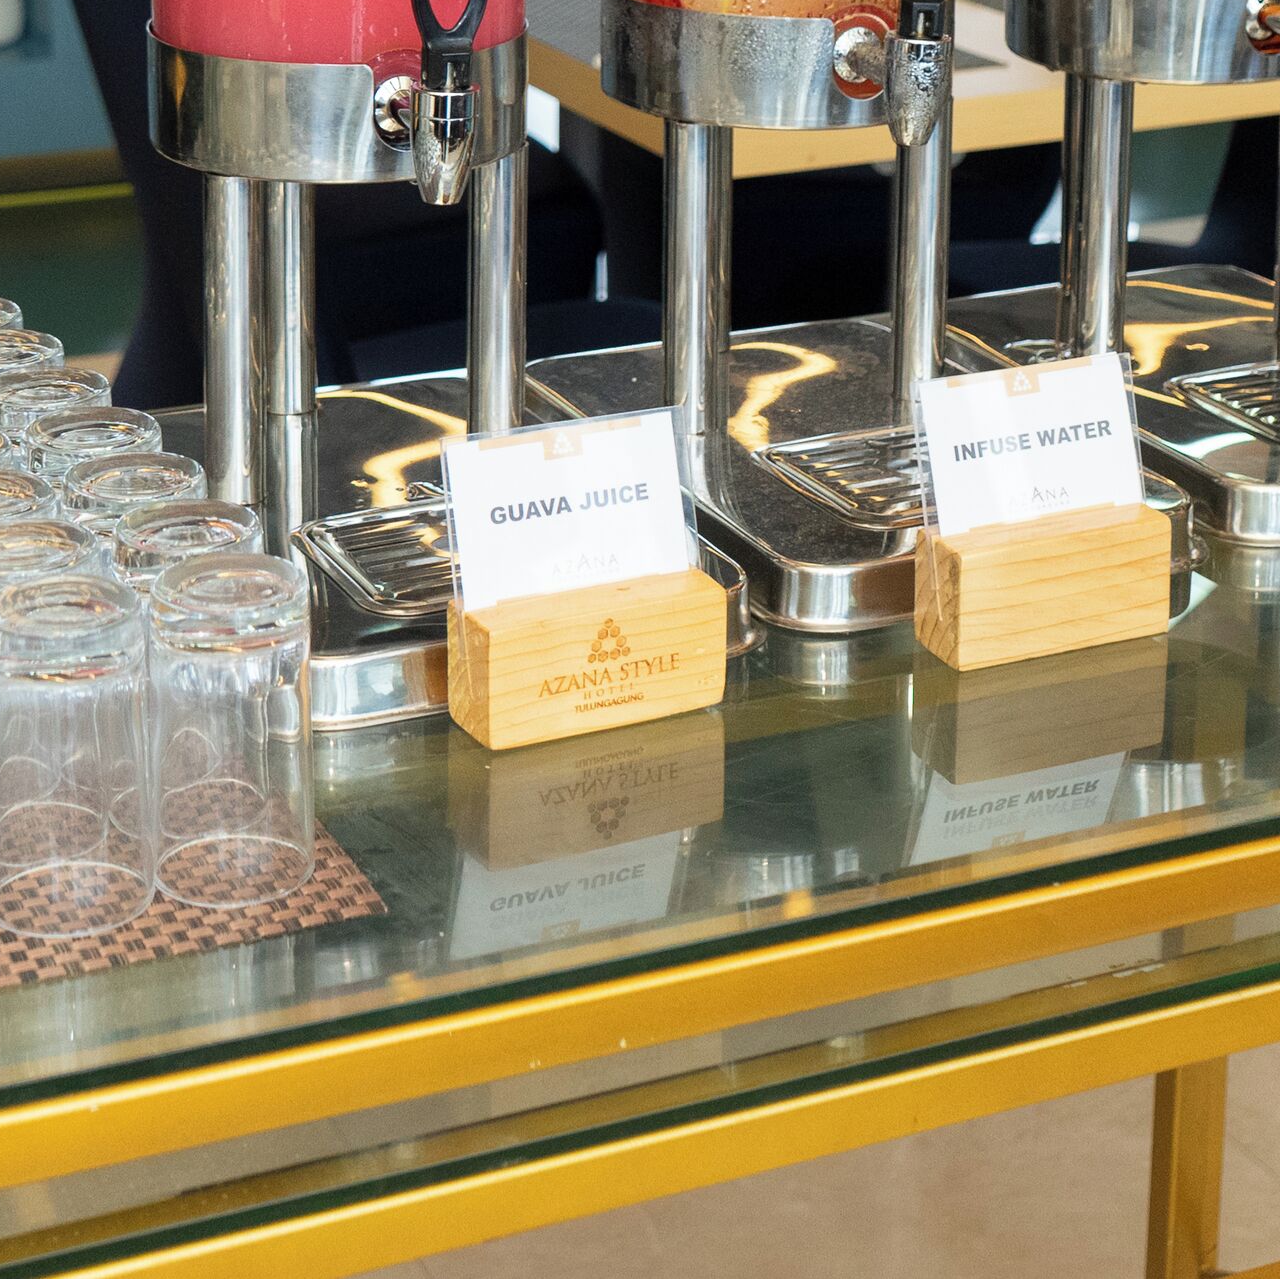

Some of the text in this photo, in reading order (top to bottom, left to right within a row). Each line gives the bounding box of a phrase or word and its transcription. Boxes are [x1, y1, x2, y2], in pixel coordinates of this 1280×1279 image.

[953, 419, 1111, 461] INFUSE WATER
[490, 482, 648, 524] GUAVA JUICE
[552, 552, 617, 576] AZANA
[538, 651, 680, 697] AZANA STYLE
